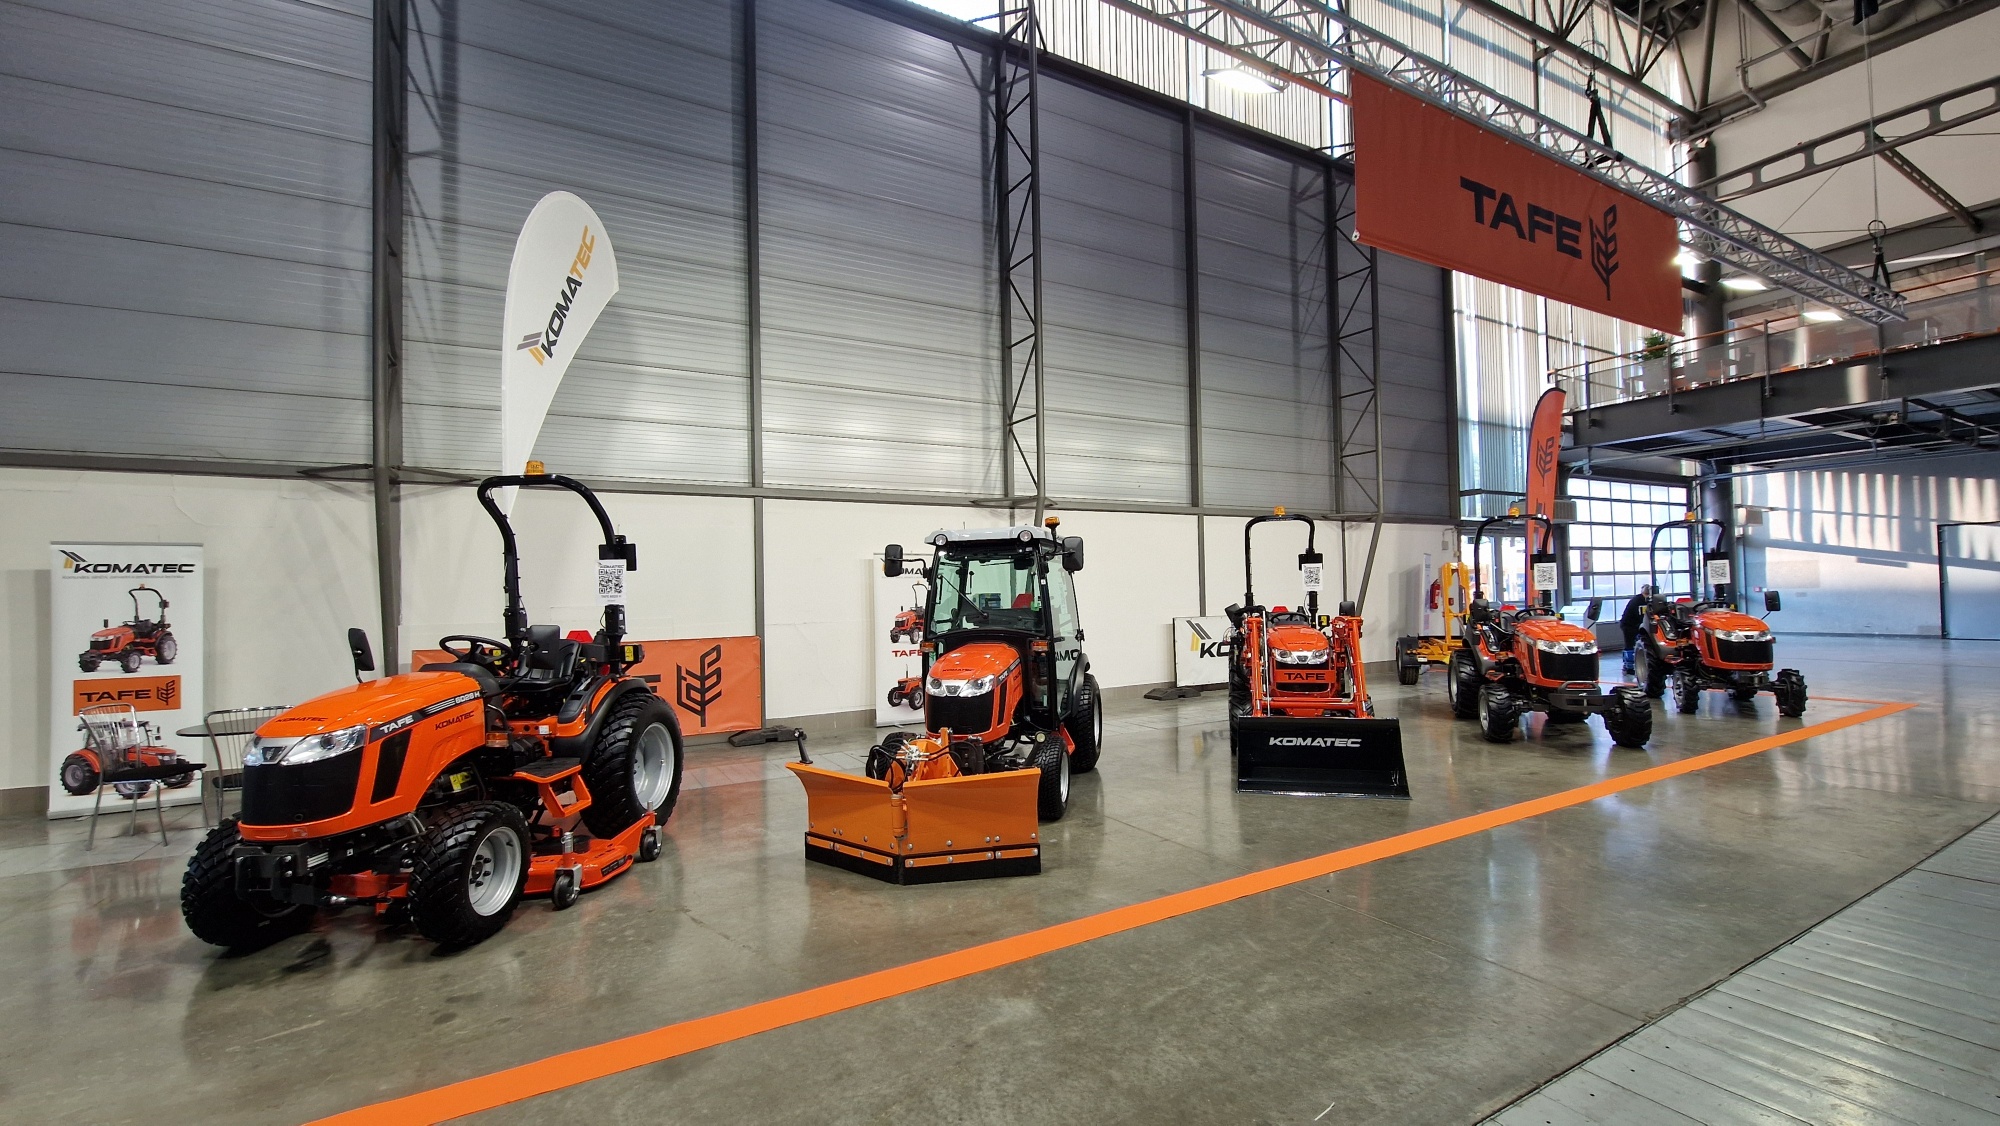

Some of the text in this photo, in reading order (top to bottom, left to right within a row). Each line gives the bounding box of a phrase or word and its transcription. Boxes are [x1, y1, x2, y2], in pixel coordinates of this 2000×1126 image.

[1460, 175, 1582, 260] TAFE
[541, 225, 596, 359] KOMATEC
[74, 563, 196, 575] KOMATEC
[1283, 672, 1326, 681] TAFE
[80, 689, 151, 703] TAFE
[379, 715, 414, 734] TAFE
[434, 710, 475, 731] KOMATEC
[1269, 737, 1362, 748] KOMATEC
